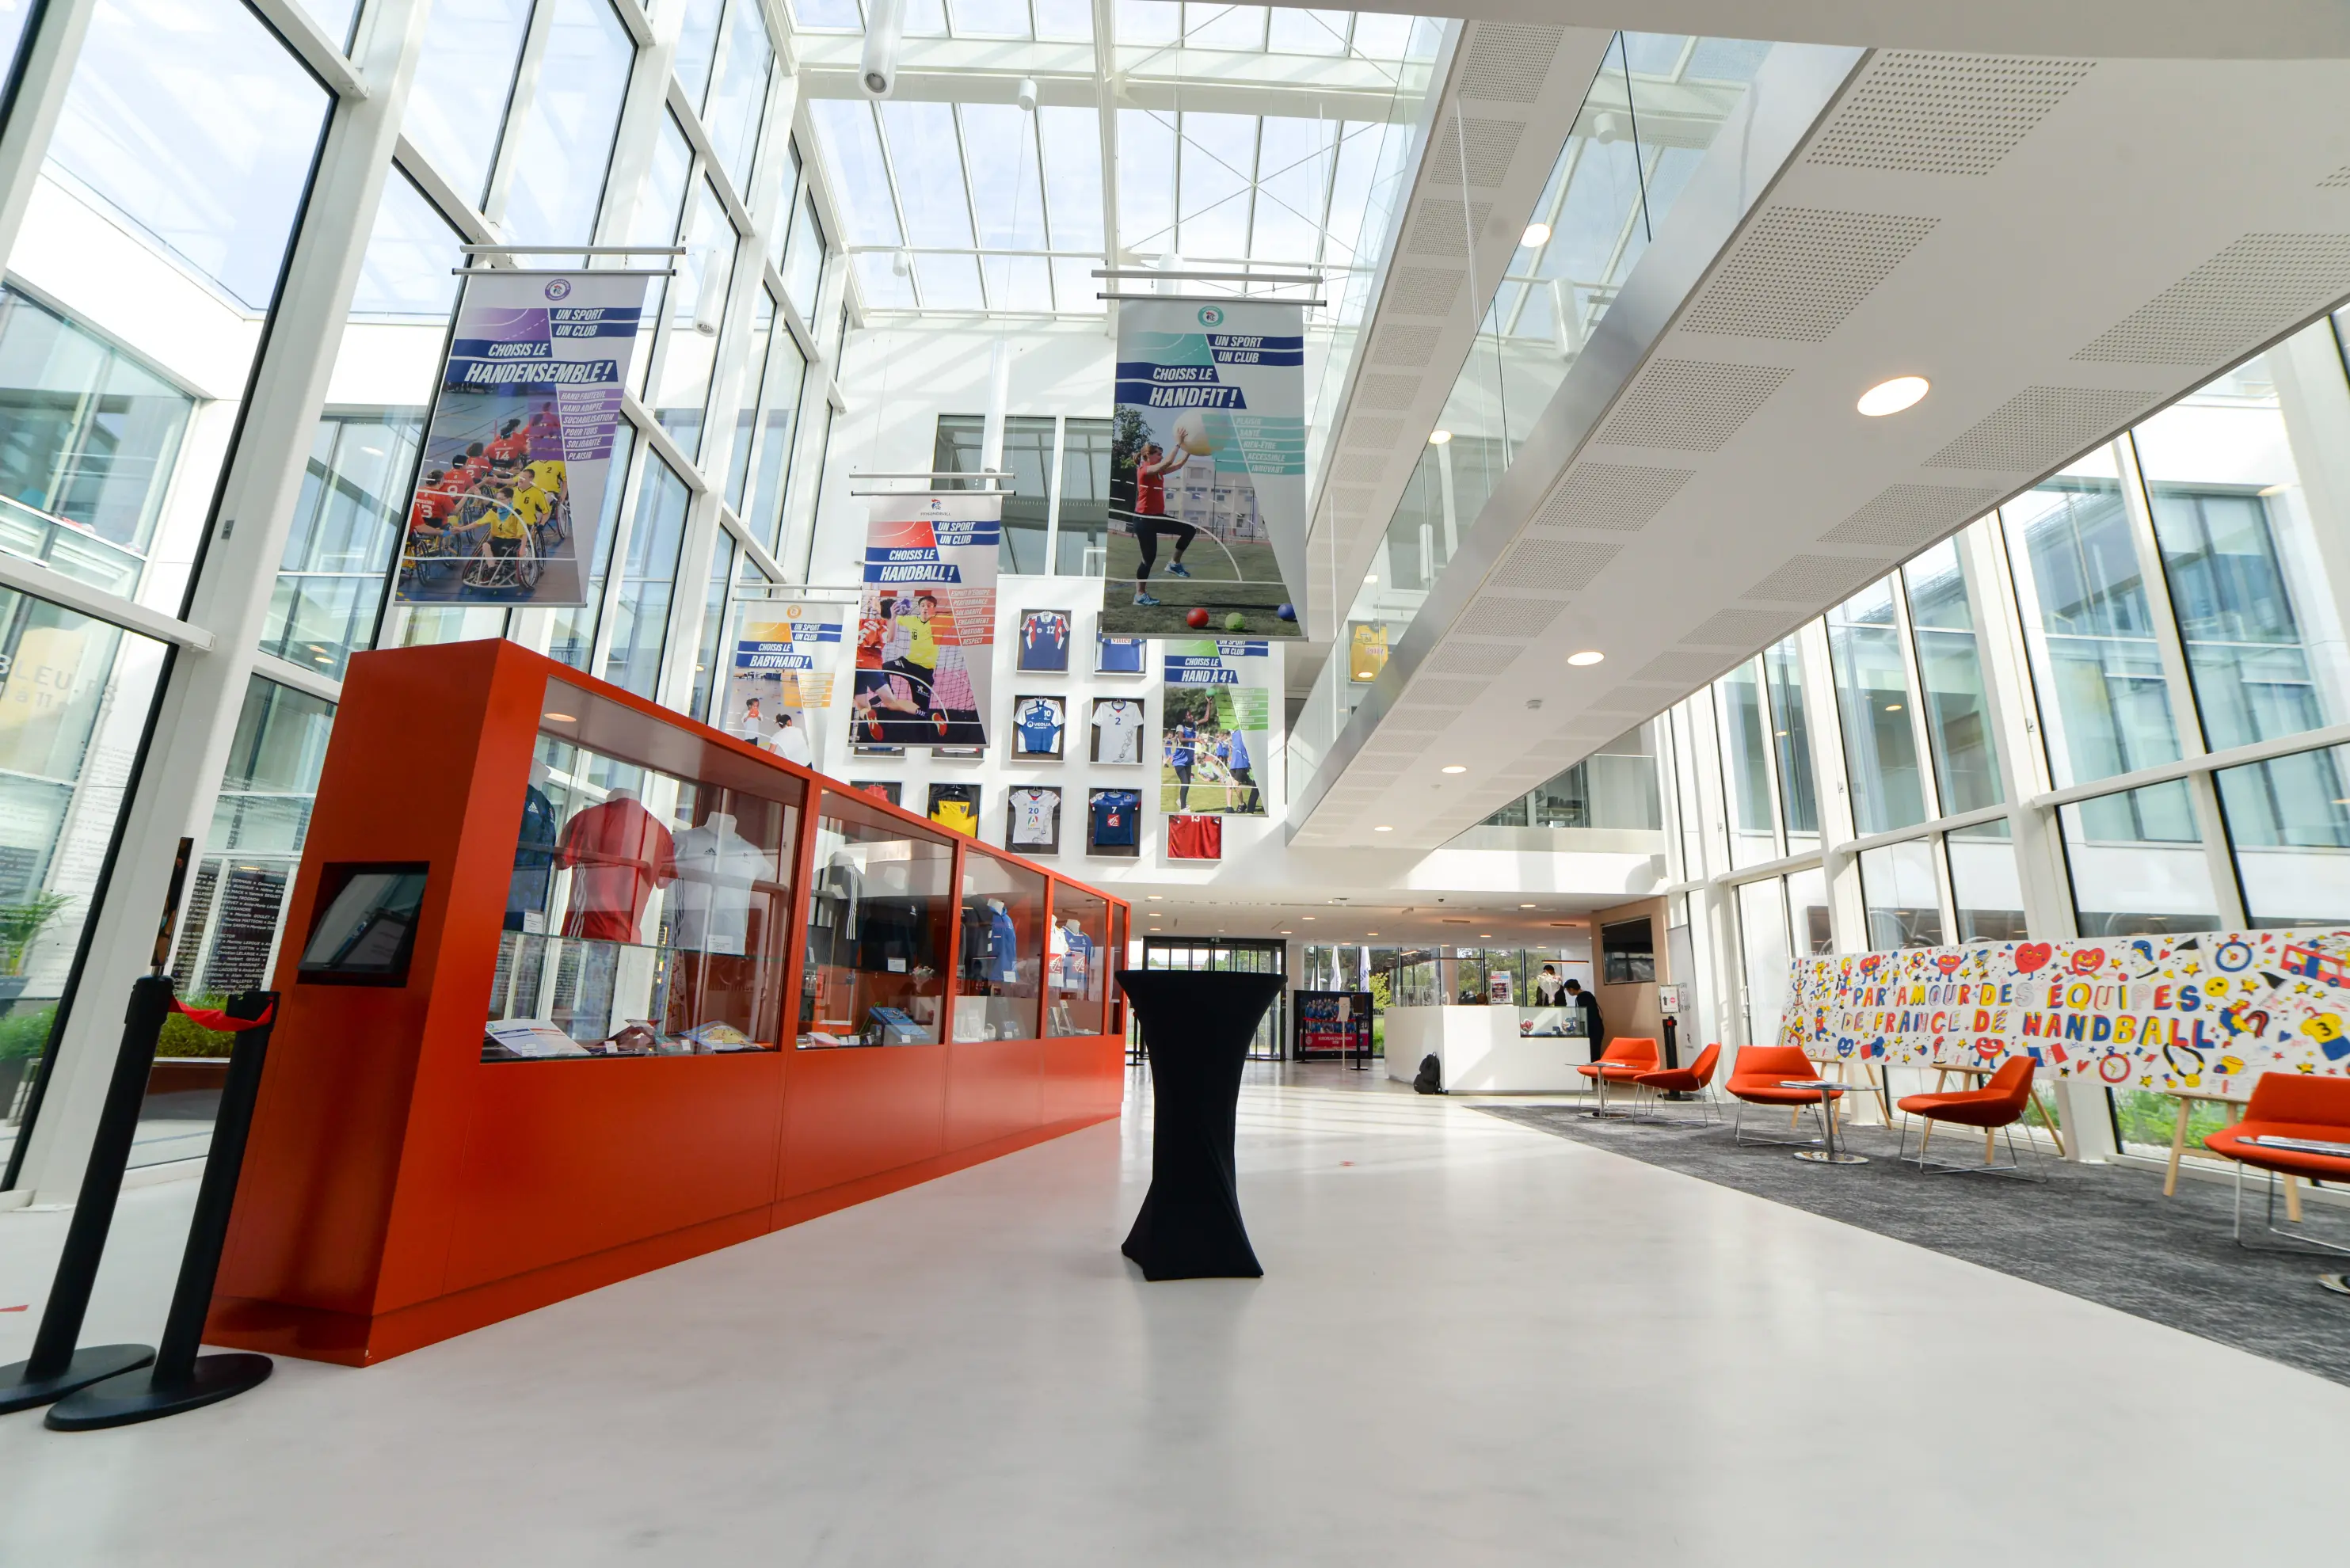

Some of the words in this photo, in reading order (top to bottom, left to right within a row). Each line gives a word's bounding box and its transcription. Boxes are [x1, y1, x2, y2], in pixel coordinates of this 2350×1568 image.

[555, 309, 569, 320] UN
[572, 309, 604, 321] SPORT
[555, 325, 569, 337] UN
[572, 325, 597, 337] CLUB
[1214, 336, 1229, 346] UN
[1231, 337, 1263, 348] SPORT
[488, 344, 531, 356] CHOISIS
[533, 343, 549, 356] LE
[1218, 352, 1233, 362] UN
[1234, 352, 1259, 363] CLUB
[1152, 368, 1197, 380] CHOISIS
[1198, 368, 1213, 380] LE
[1148, 386, 1228, 407] HANDFIT
[565, 428, 584, 436] POUR
[583, 426, 598, 435] TOUS
[568, 451, 592, 460] PLAISIR
[938, 522, 949, 531] UN
[950, 522, 976, 531] SPORT
[940, 535, 951, 544] UN
[952, 535, 972, 544] CLUB
[889, 550, 923, 561] CHOISIS
[924, 550, 935, 559] LE
[879, 565, 946, 580] HANDBALL
[749, 656, 803, 668] BABYHAND
[1182, 671, 1209, 682] HAND
[1220, 671, 1227, 682] 4
[1853, 987, 1887, 1007] PAR
[1895, 985, 1971, 1007] AMOUR
[1979, 982, 2036, 1007] DES
[2047, 972, 2202, 1012] ÉQUIPES
[1841, 1011, 1865, 1032] DE
[1873, 1010, 1961, 1034] FRANCE
[1973, 1008, 2009, 1033] DE
[2022, 1011, 2215, 1049] HANDBALL
[2315, 1022, 2333, 1036] 3
